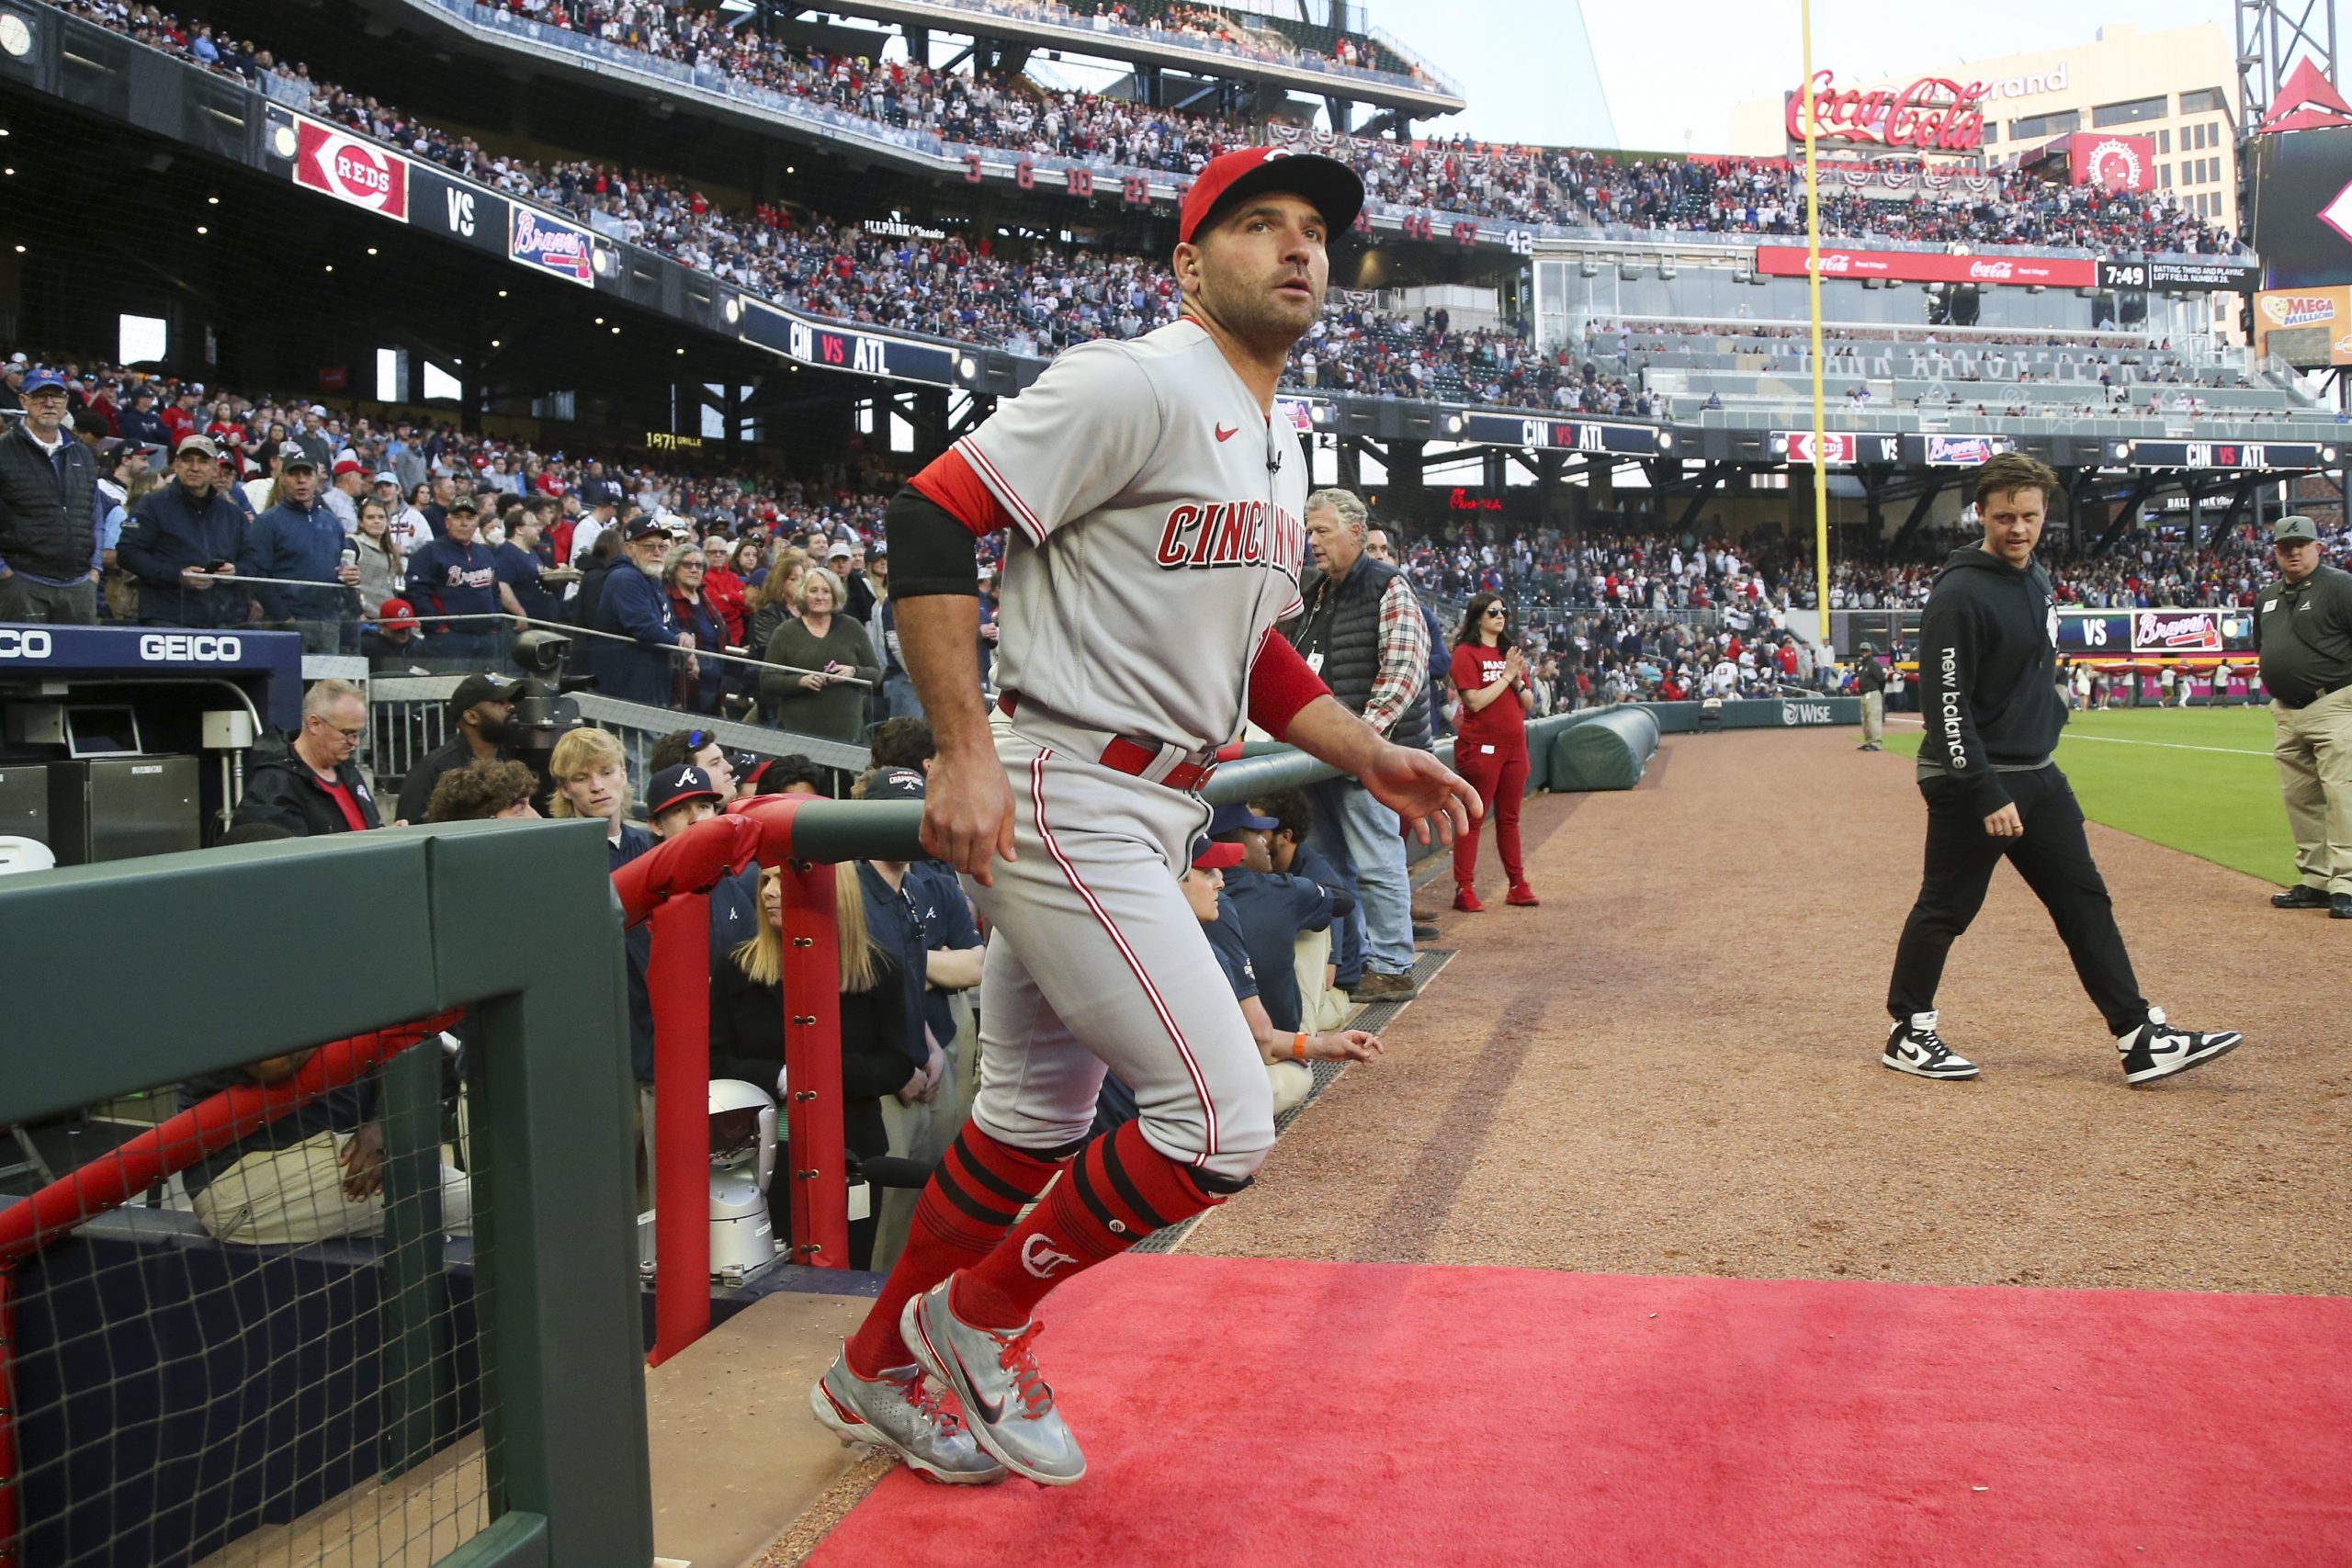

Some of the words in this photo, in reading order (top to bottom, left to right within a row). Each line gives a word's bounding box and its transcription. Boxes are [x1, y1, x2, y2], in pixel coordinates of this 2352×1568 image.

[336, 154, 390, 194] REDS
[965, 153, 981, 183] 3
[1016, 161, 1035, 189] 6
[1066, 167, 1092, 197] 10
[1122, 175, 1151, 204] 21
[447, 186, 475, 237] VS
[514, 210, 581, 254] Braves
[1402, 214, 1433, 241] 44
[1452, 220, 1478, 247] 47
[1506, 229, 1533, 255] 42
[2106, 265, 2144, 286] 7:49
[2153, 265, 2182, 274] BATTING
[2182, 265, 2201, 275] THIRD
[2202, 267, 2217, 276] AND
[2217, 268, 2245, 276] PLAYING
[2153, 273, 2169, 281] LEFT
[2190, 274, 2219, 283] NUMBER
[2285, 299, 2335, 314] MEGA
[790, 321, 813, 362] CIN
[822, 334, 843, 363] VS
[853, 337, 890, 375] ATL
[1522, 420, 1549, 446] CIN
[1555, 425, 1573, 445] VS
[1578, 425, 1607, 451] ATL
[1880, 438, 1898, 460] VS
[1930, 437, 1981, 460] Braves
[2186, 444, 2212, 467] CIN
[2219, 446, 2235, 465] VS
[2242, 446, 2269, 467] ATL
[2082, 618, 2107, 647] VS
[2136, 614, 2207, 647] Braves
[140, 634, 242, 661] GEICO
[1941, 648, 1956, 688] new
[1942, 691, 1967, 769] balance
